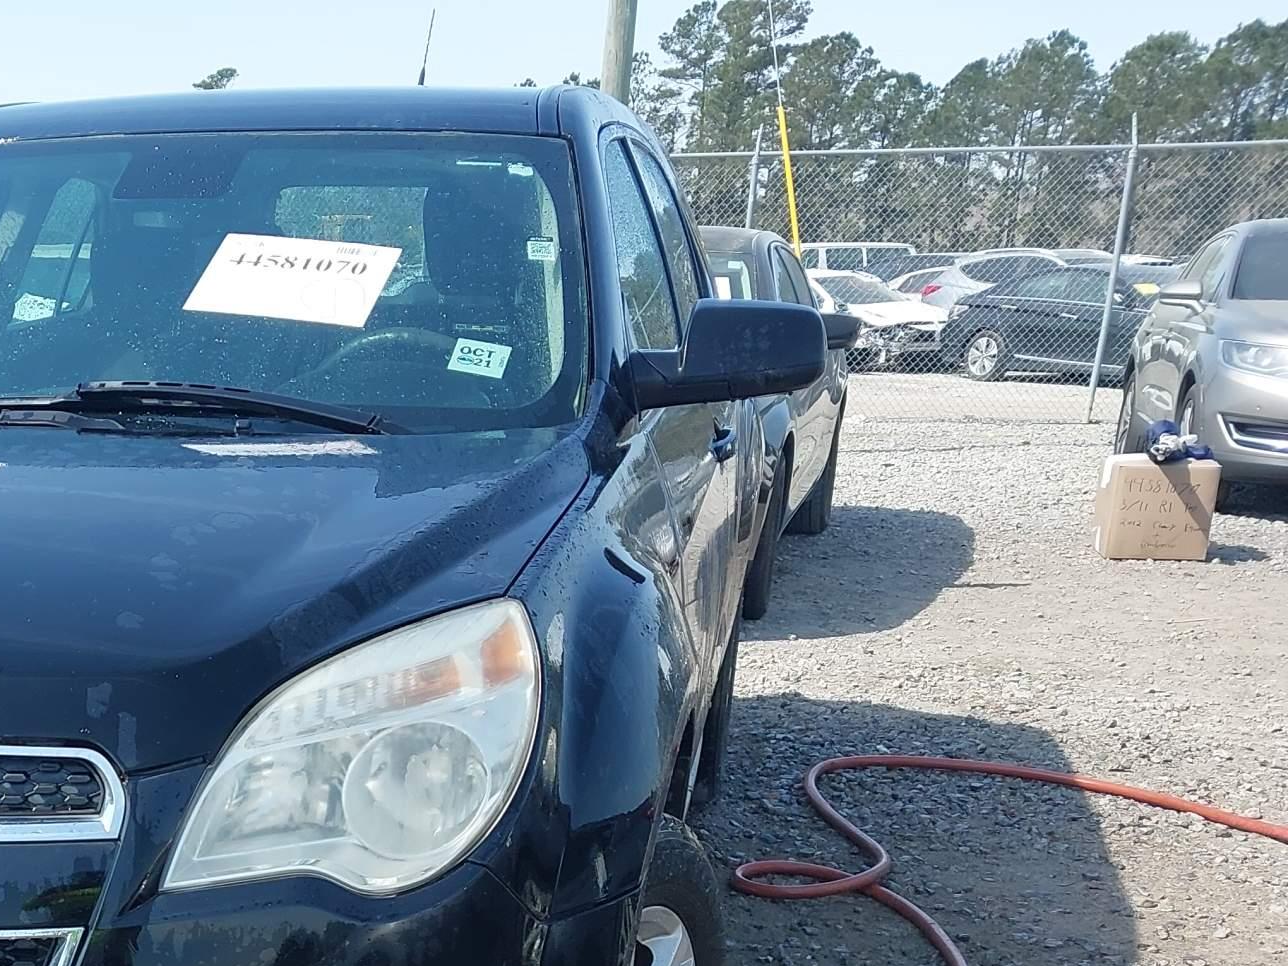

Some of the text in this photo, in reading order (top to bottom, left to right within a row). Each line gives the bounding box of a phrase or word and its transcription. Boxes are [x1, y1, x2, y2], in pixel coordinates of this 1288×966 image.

[229, 252, 368, 275] 44581070
[459, 345, 497, 359] OCT
[472, 358, 492, 369] 21
